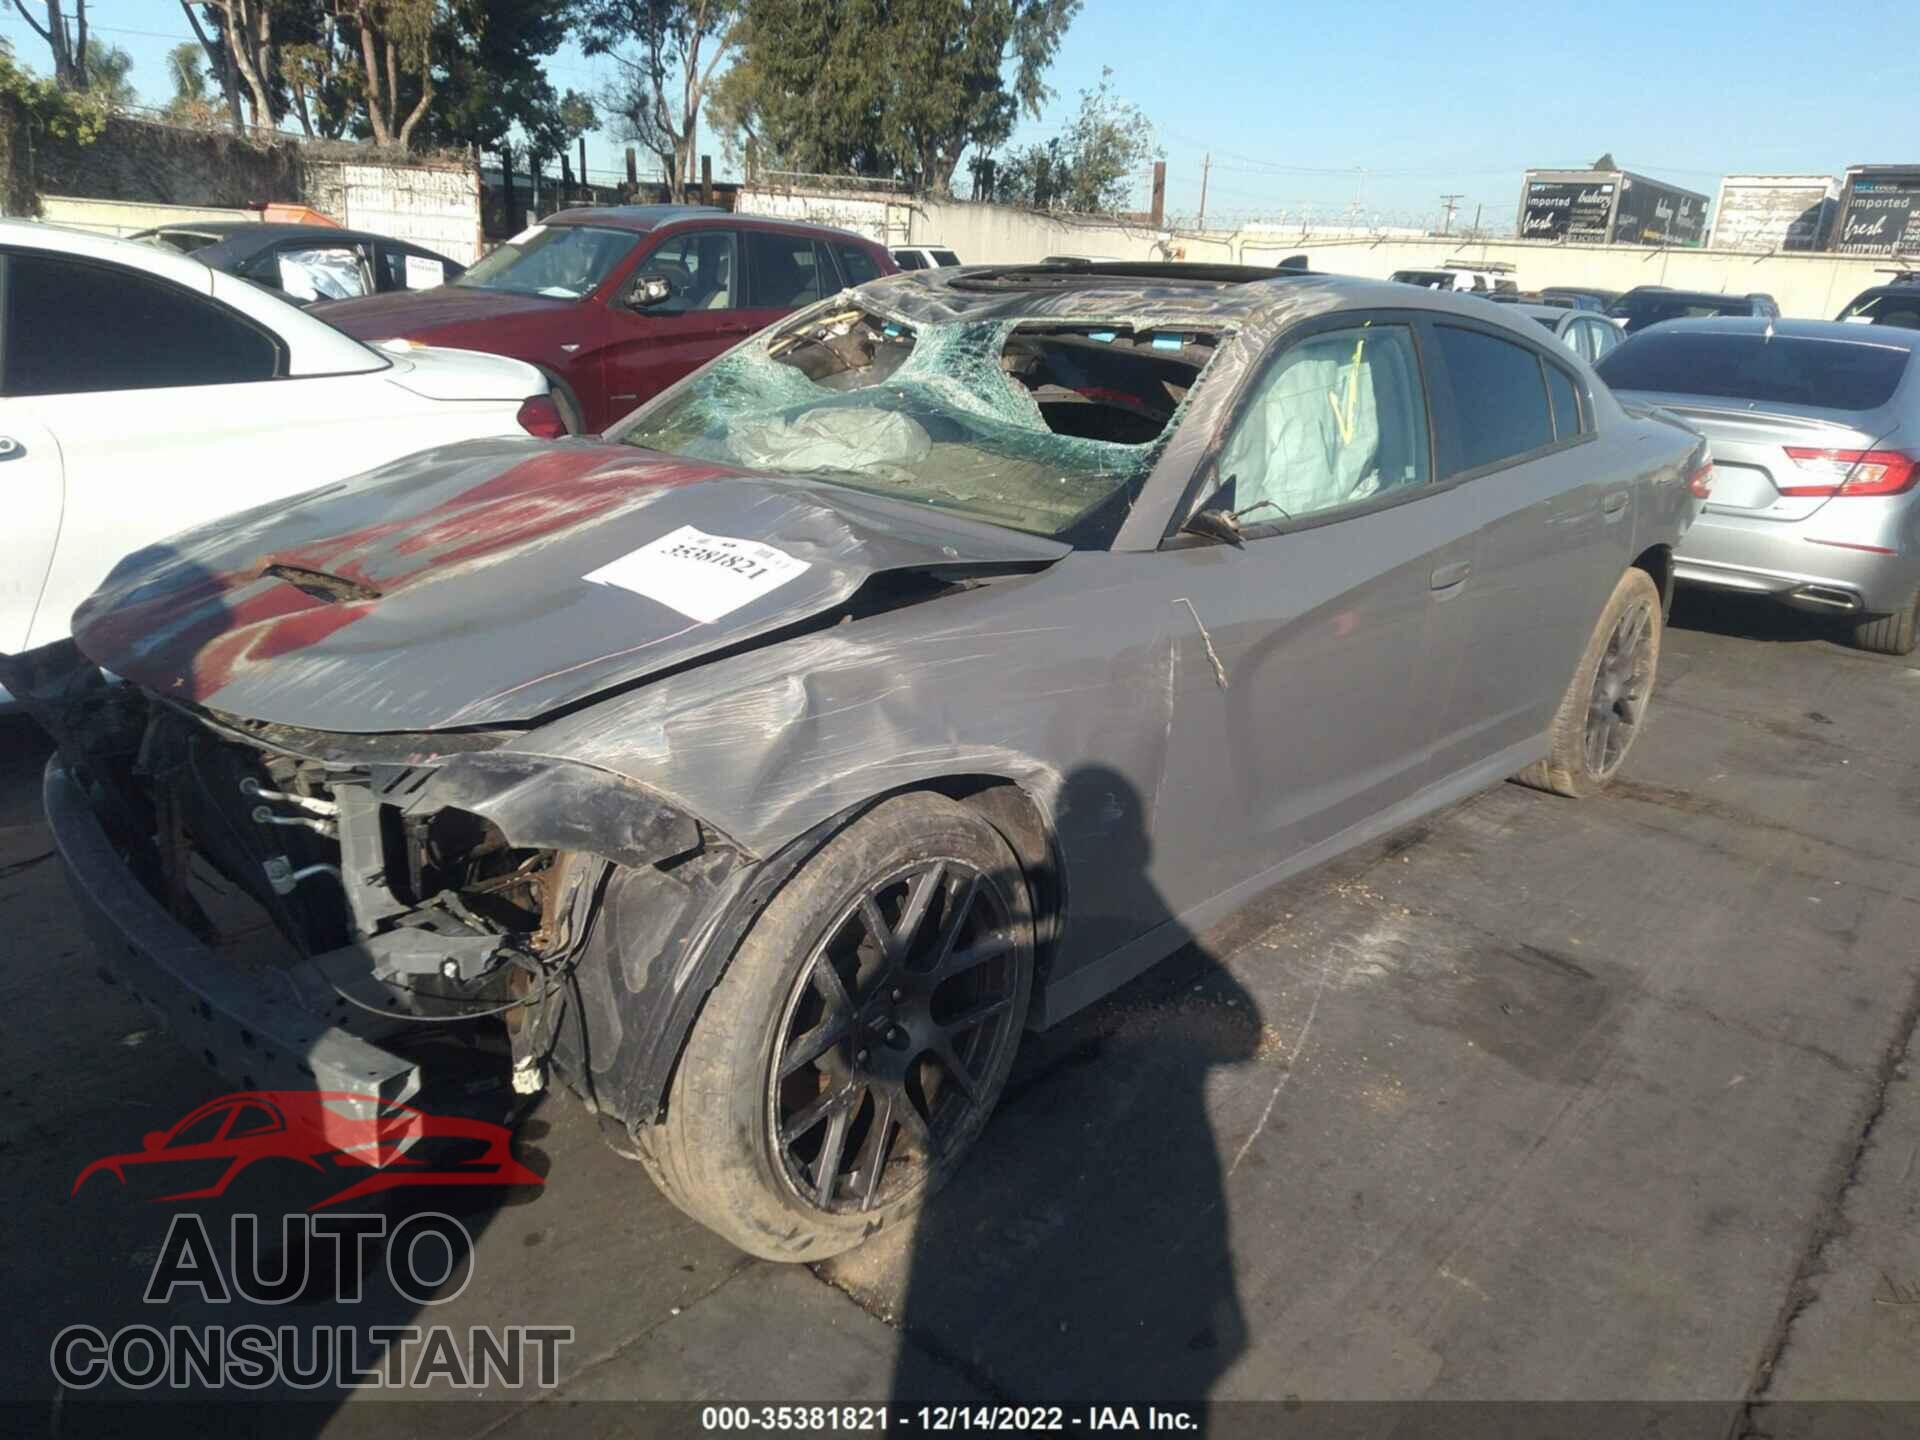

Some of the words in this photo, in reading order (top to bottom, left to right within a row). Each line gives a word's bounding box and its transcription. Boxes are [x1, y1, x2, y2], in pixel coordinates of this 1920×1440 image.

[1527, 196, 1570, 208] imported
[1850, 196, 1910, 210] imported
[1523, 211, 1554, 235] fresh
[1844, 214, 1887, 241] fresh
[660, 544, 768, 579] 35381821
